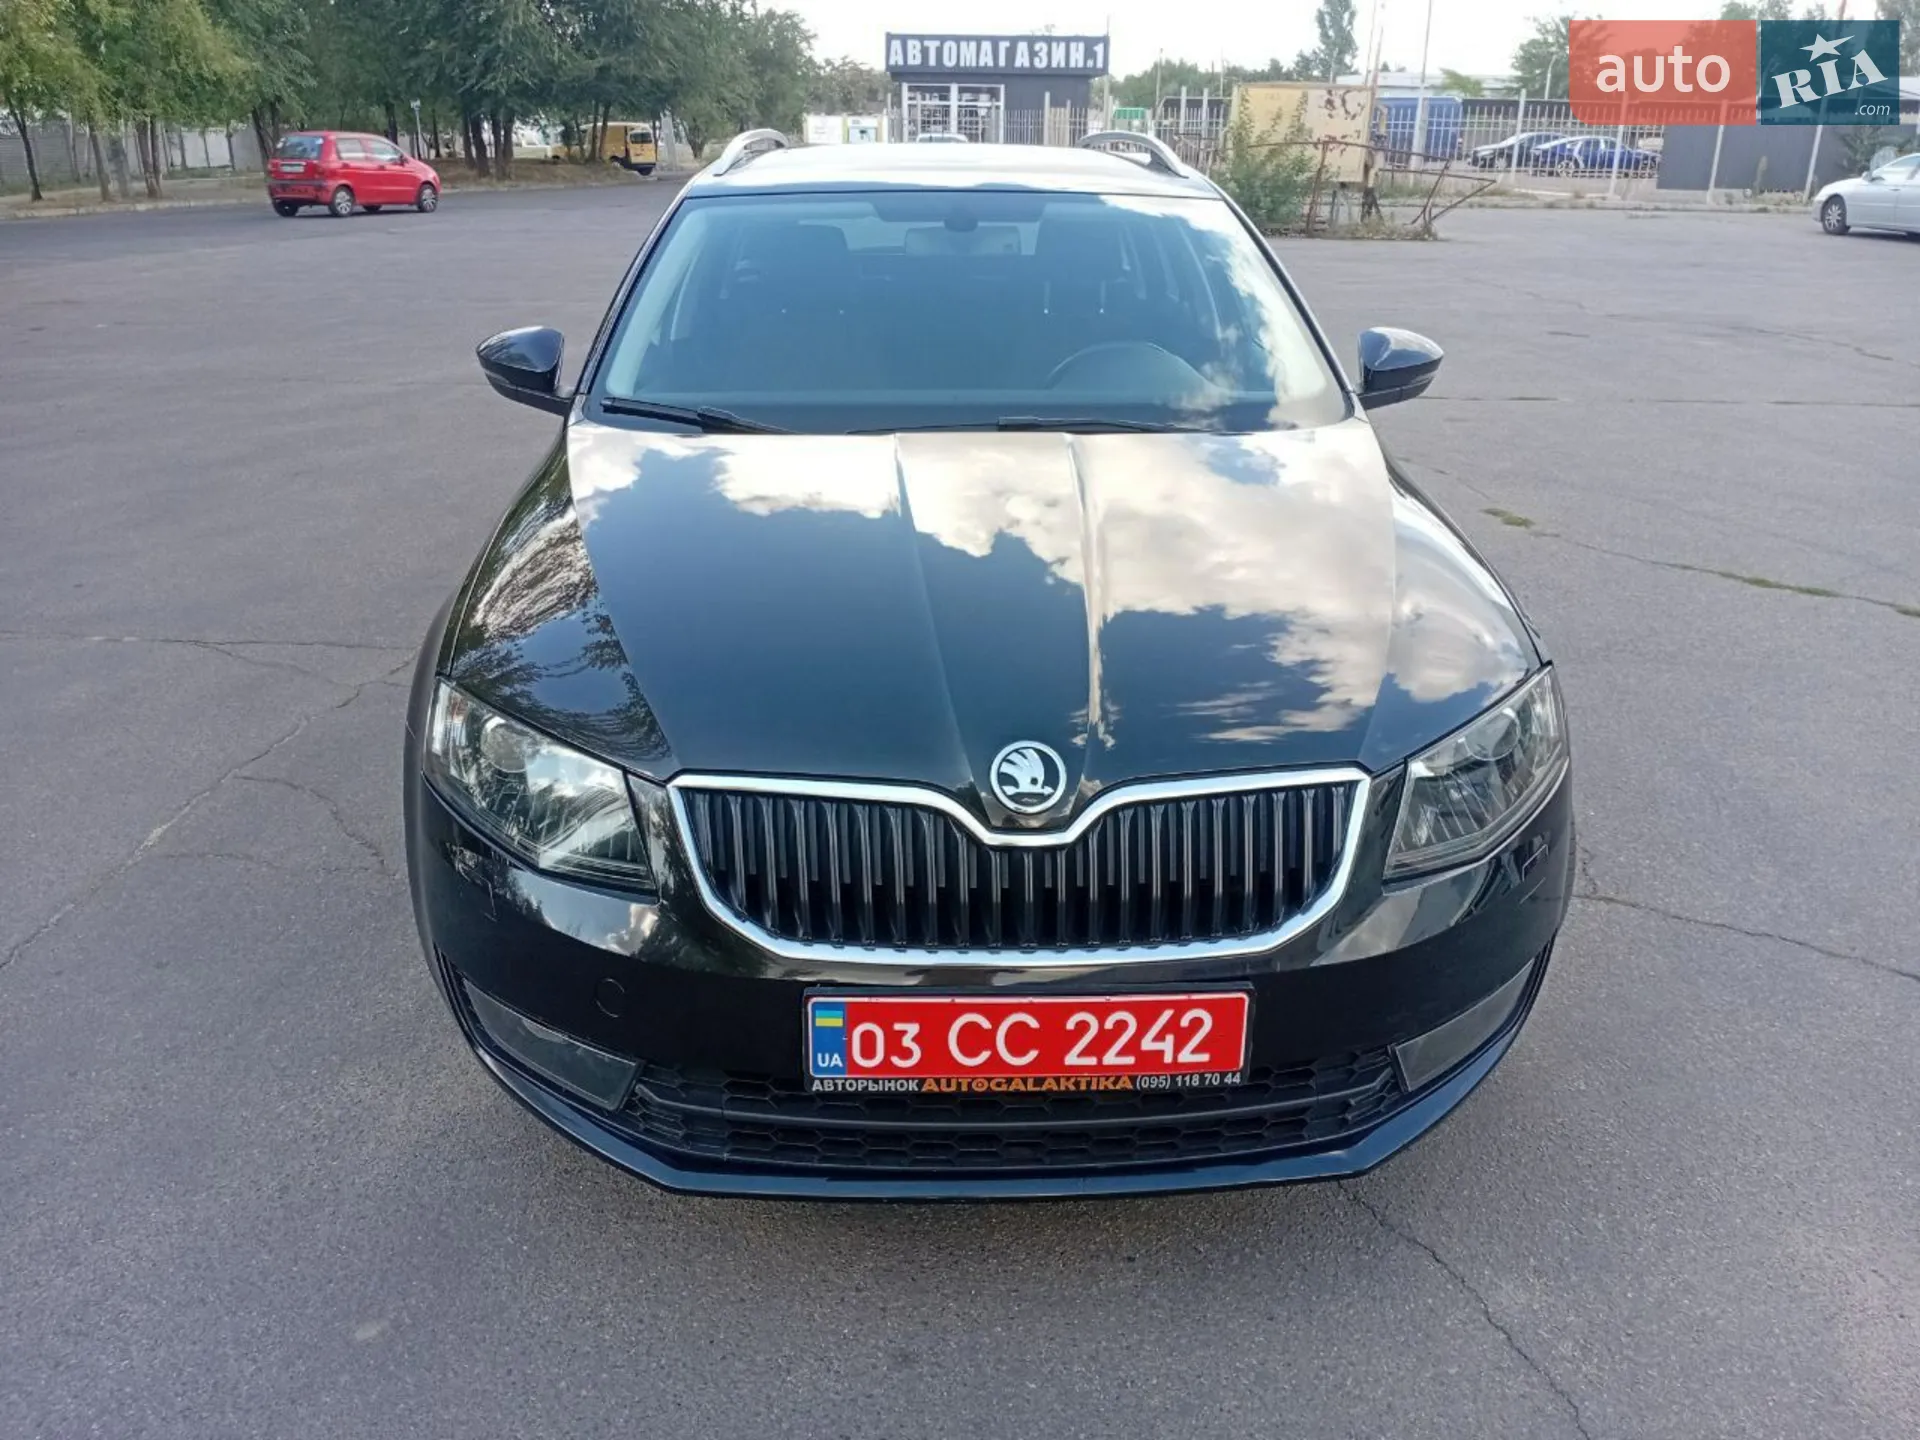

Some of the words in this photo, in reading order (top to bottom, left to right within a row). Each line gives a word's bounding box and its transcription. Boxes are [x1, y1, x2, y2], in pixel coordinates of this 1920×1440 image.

[888, 39, 1085, 68] АВТОМАГАЗИН
[852, 1022, 922, 1068] 03
[947, 1012, 1040, 1066] CC
[1064, 1008, 1213, 1066] 2242
[817, 1053, 843, 1068] UA
[812, 1079, 919, 1092] АВТОРЫНОК
[921, 1076, 1133, 1092] AUTOGALAKTIKA
[1136, 1074, 1171, 1090] (095)
[1176, 1074, 1199, 1087] 118
[1204, 1073, 1220, 1085] 70
[1224, 1071, 1241, 1084] 44
